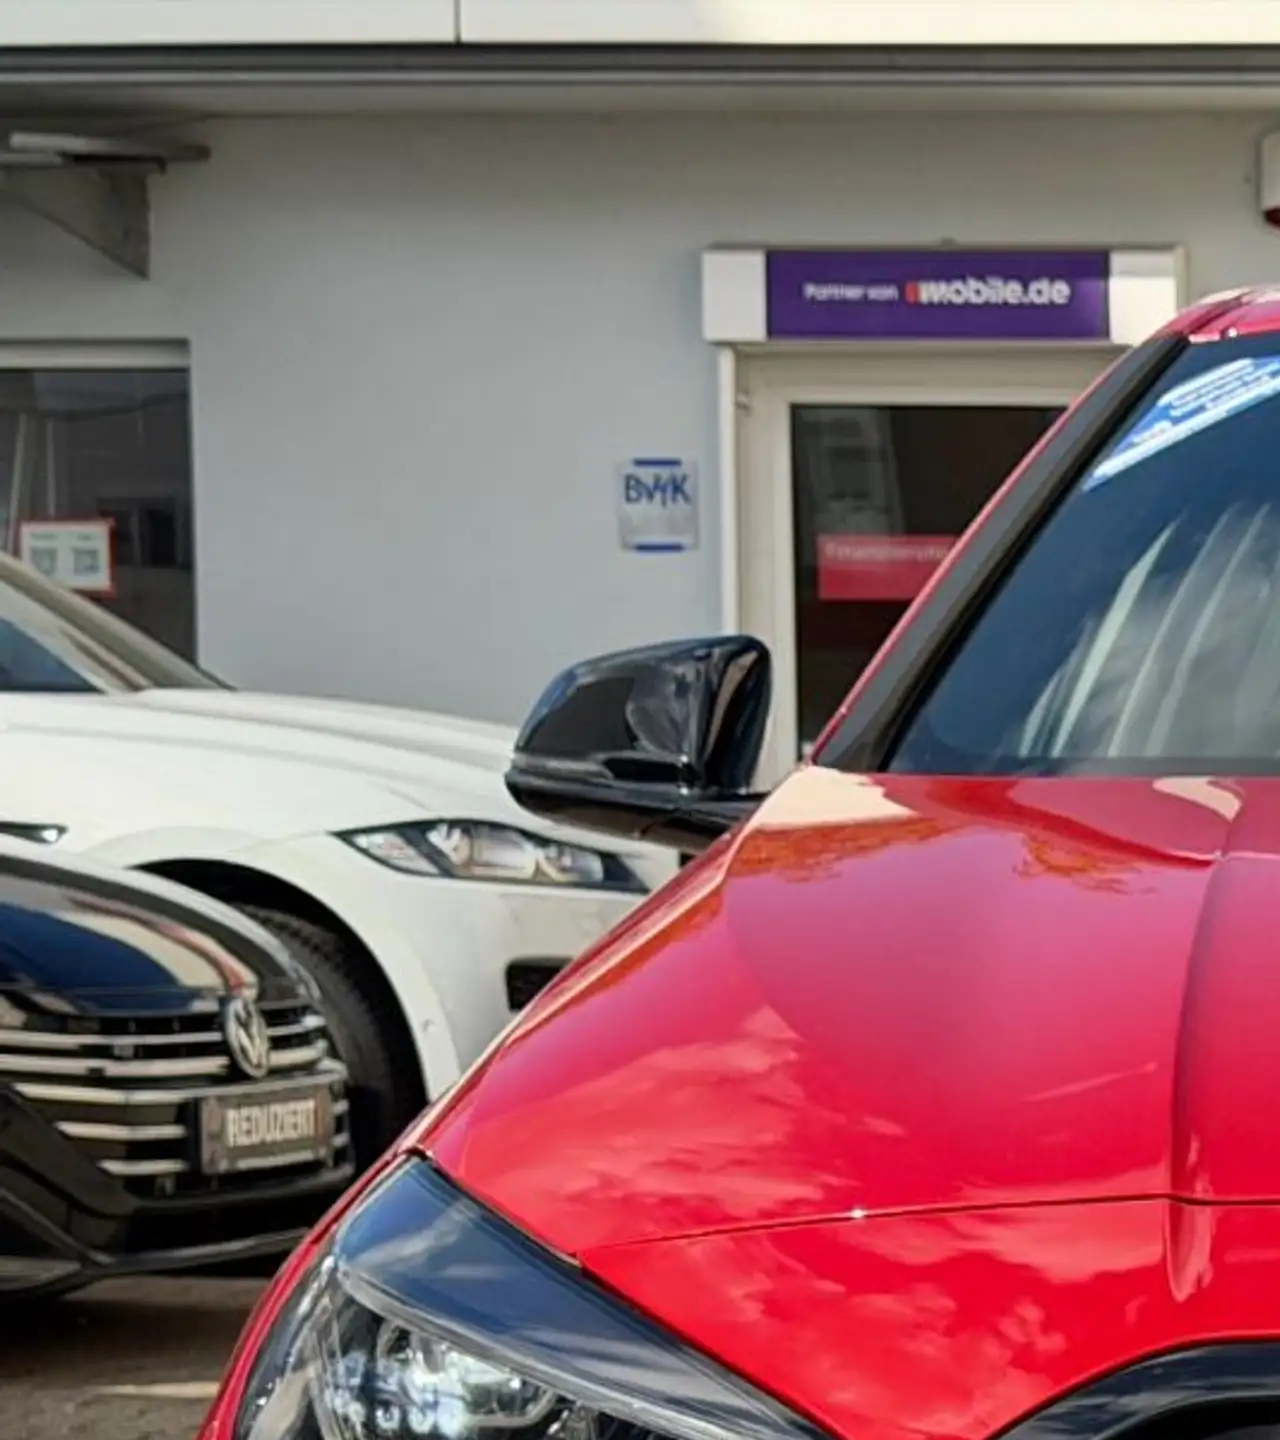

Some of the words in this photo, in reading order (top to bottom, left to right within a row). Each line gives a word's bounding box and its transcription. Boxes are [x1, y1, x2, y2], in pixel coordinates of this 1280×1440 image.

[804, 282, 863, 301] Partner
[919, 276, 1070, 305] mobile.de
[226, 1098, 316, 1150] REDUZIERT
